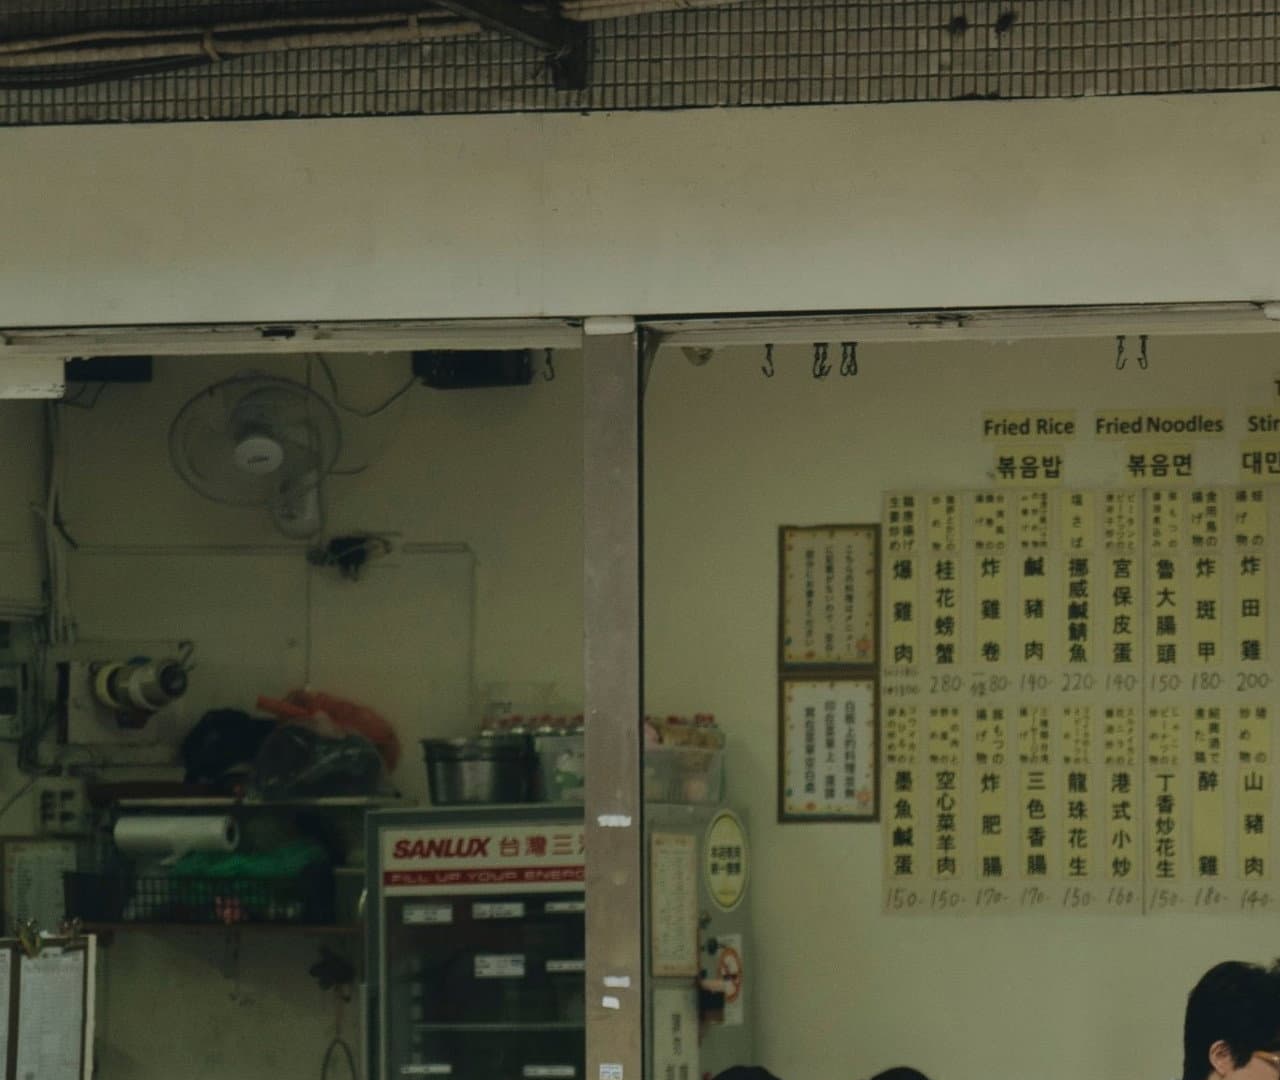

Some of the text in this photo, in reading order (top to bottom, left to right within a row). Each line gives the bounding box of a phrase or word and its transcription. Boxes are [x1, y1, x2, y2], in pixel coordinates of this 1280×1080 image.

[984, 418, 1074, 436] Fried Rice
[998, 454, 1061, 479] 볶음밥
[1096, 416, 1223, 434] Fried Noodles
[1128, 453, 1192, 478] 볶음면
[1112, 558, 1132, 663] 宮保皮蛋
[1241, 556, 1261, 661] 炸田雞
[393, 834, 585, 858] SANLUX 台灣三
[936, 771, 956, 876] 空心菜羊肉
[981, 773, 1002, 877] 炸肥腸
[1026, 772, 1047, 876] 三色香腸
[1068, 772, 1088, 877] 龍珠花生
[1112, 772, 1132, 877] 港式小炒
[1156, 774, 1176, 879] 丁香炒花生
[1244, 772, 1265, 876] 山豬肉
[391, 873, 432, 884] FILL
[436, 873, 460, 883] UP
[465, 871, 519, 882] YOUR
